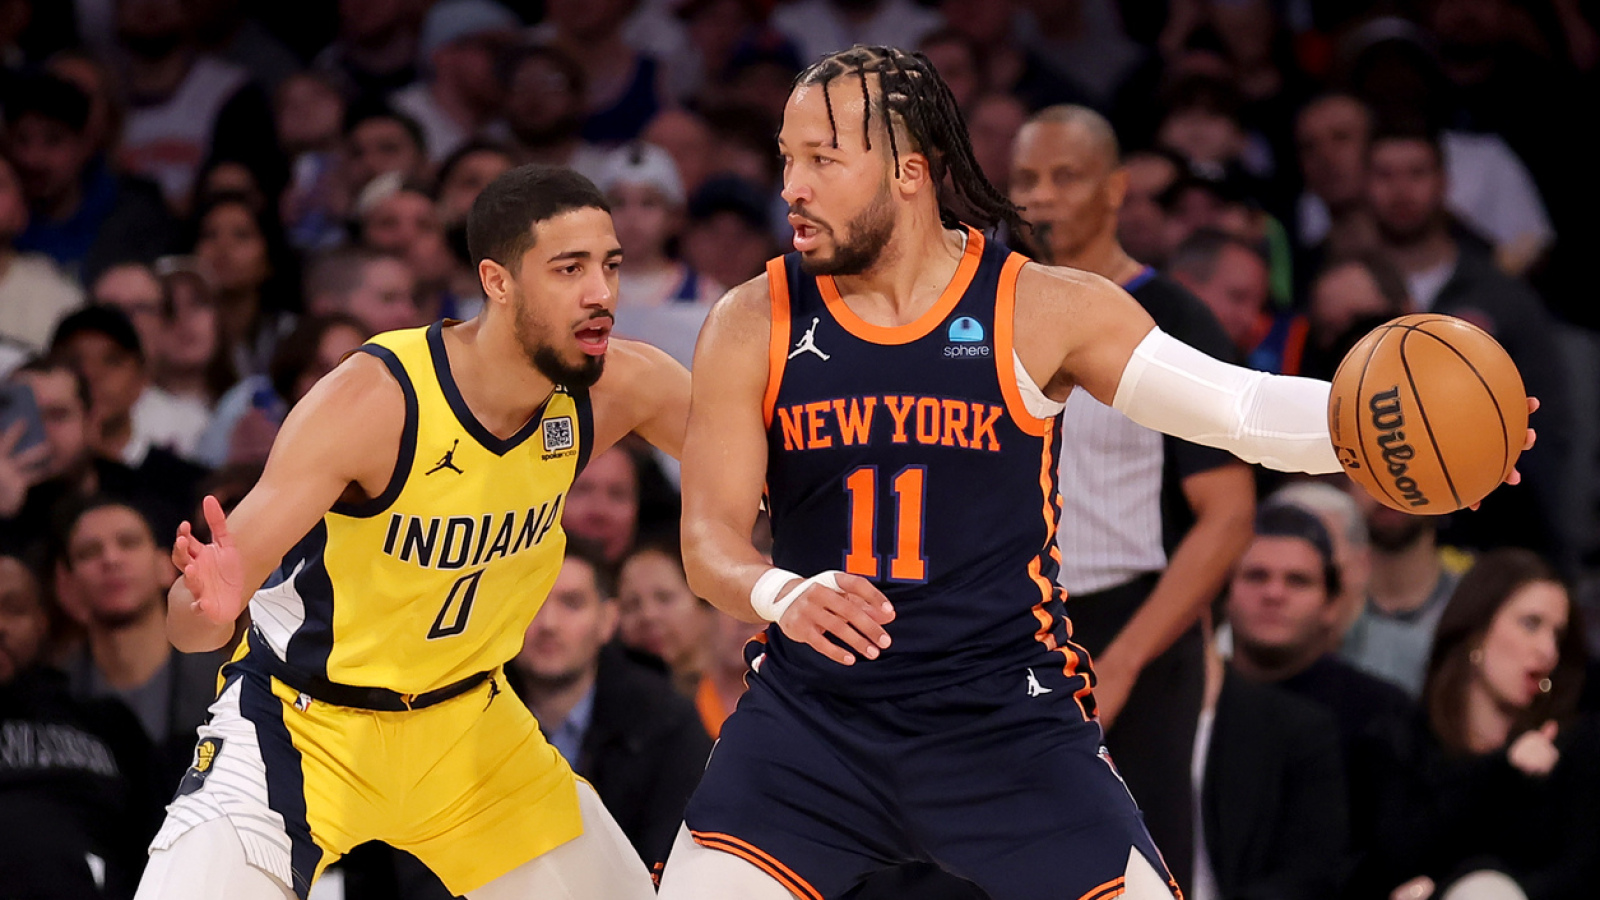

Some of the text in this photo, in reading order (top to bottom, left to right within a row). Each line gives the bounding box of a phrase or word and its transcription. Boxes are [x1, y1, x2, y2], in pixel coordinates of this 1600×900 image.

[943, 344, 990, 359] sphere
[777, 395, 1004, 452] NEW YORK
[1368, 385, 1430, 507] Wilson
[382, 492, 562, 570] INDIANA
[842, 464, 929, 584] 11
[425, 566, 488, 641] 0
